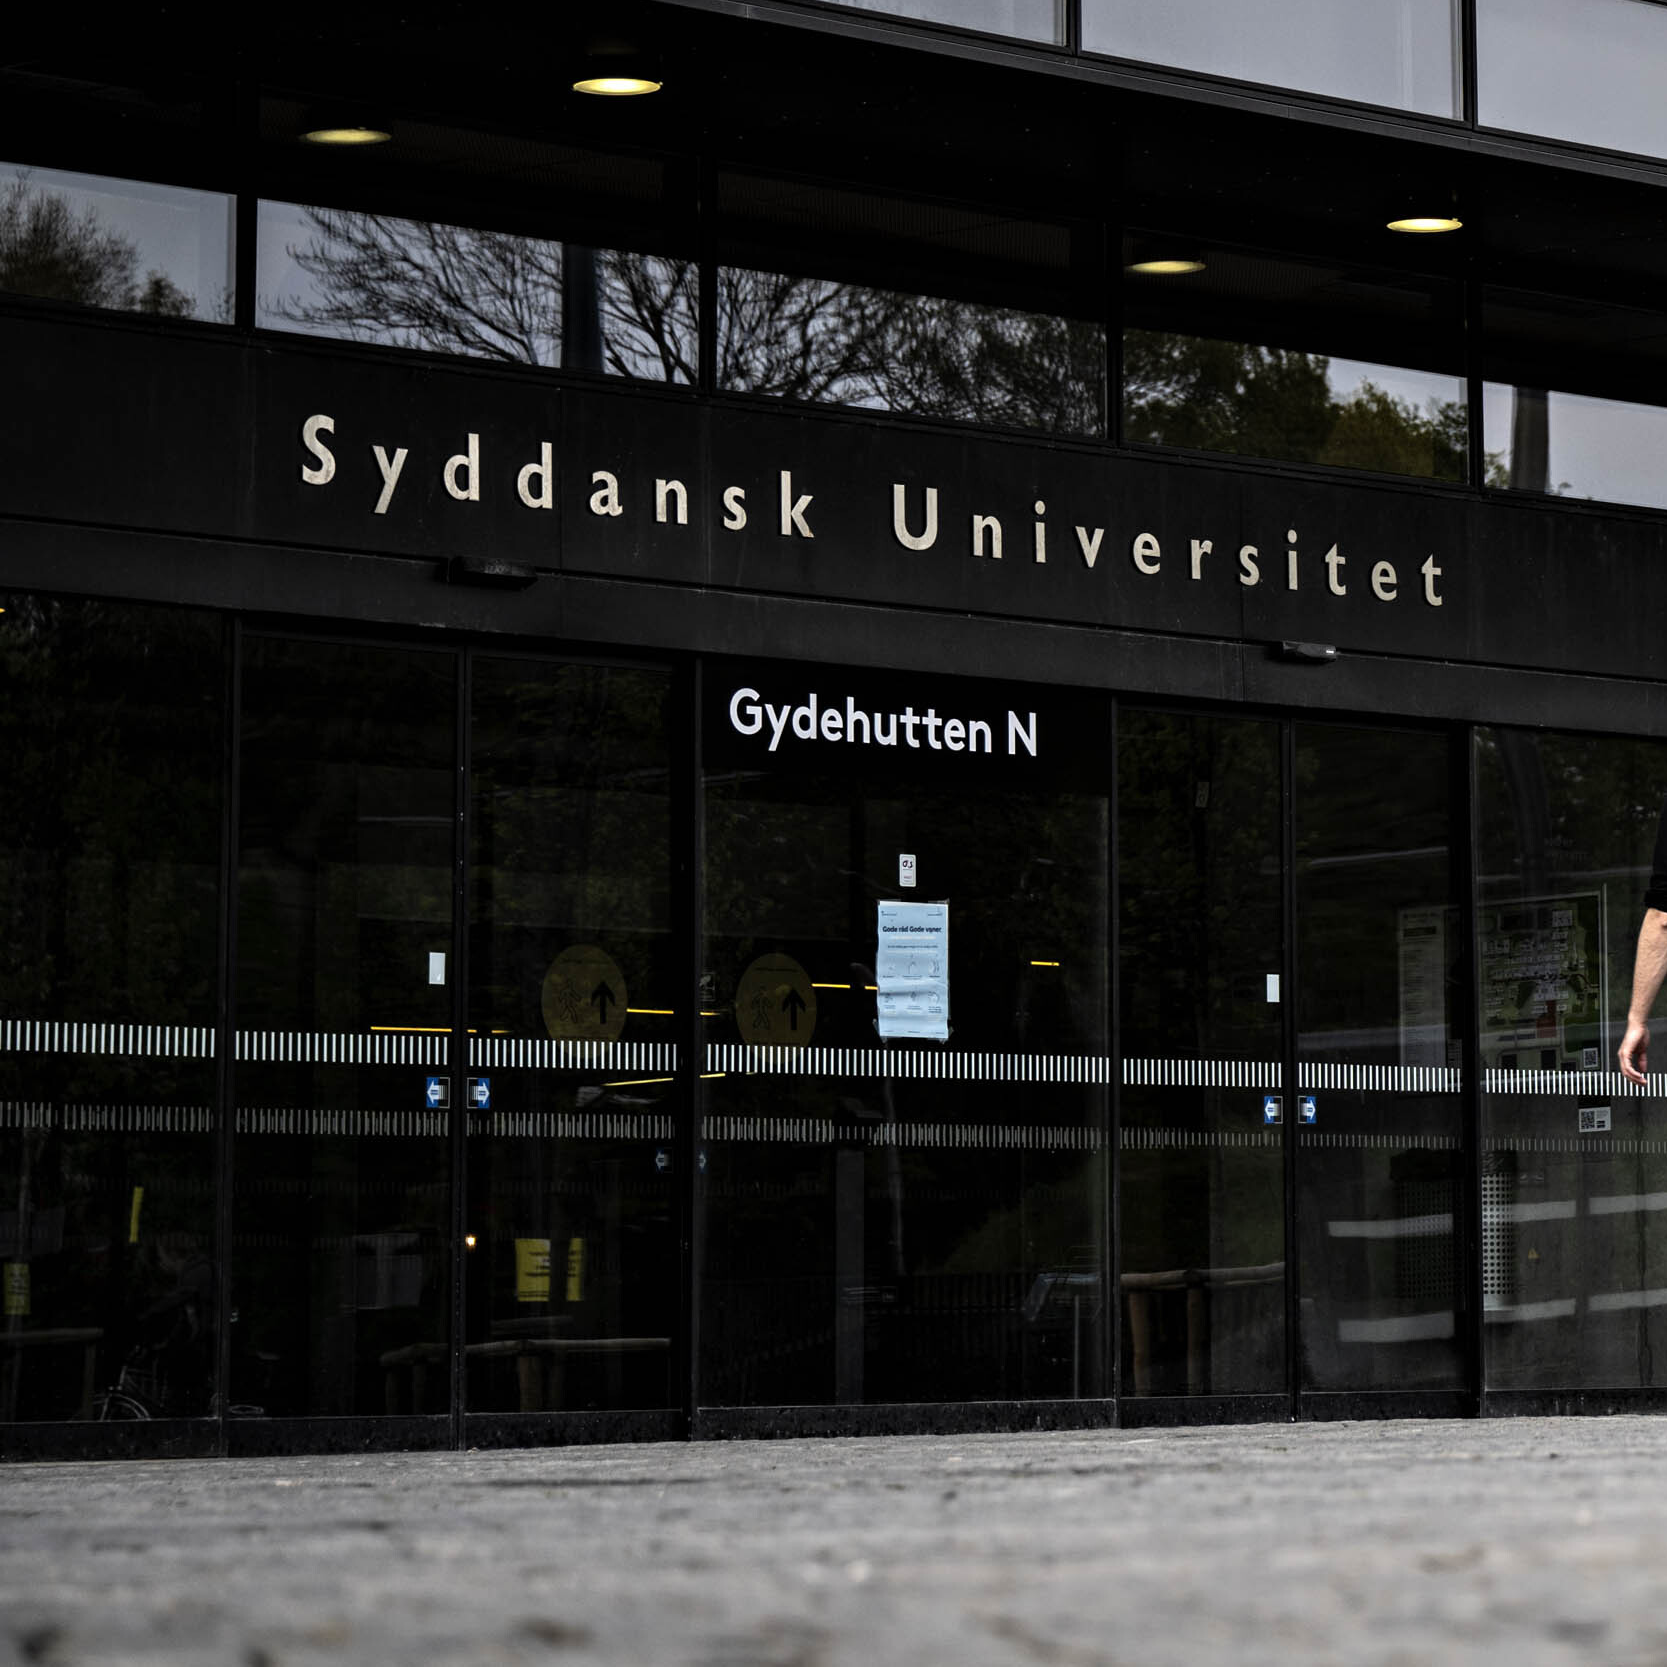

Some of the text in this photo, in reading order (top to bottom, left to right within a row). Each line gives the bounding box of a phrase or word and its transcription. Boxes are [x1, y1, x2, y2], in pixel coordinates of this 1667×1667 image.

[300, 414, 1443, 607] Syddansk Universitet
[729, 687, 1038, 757] Gydehutten N
